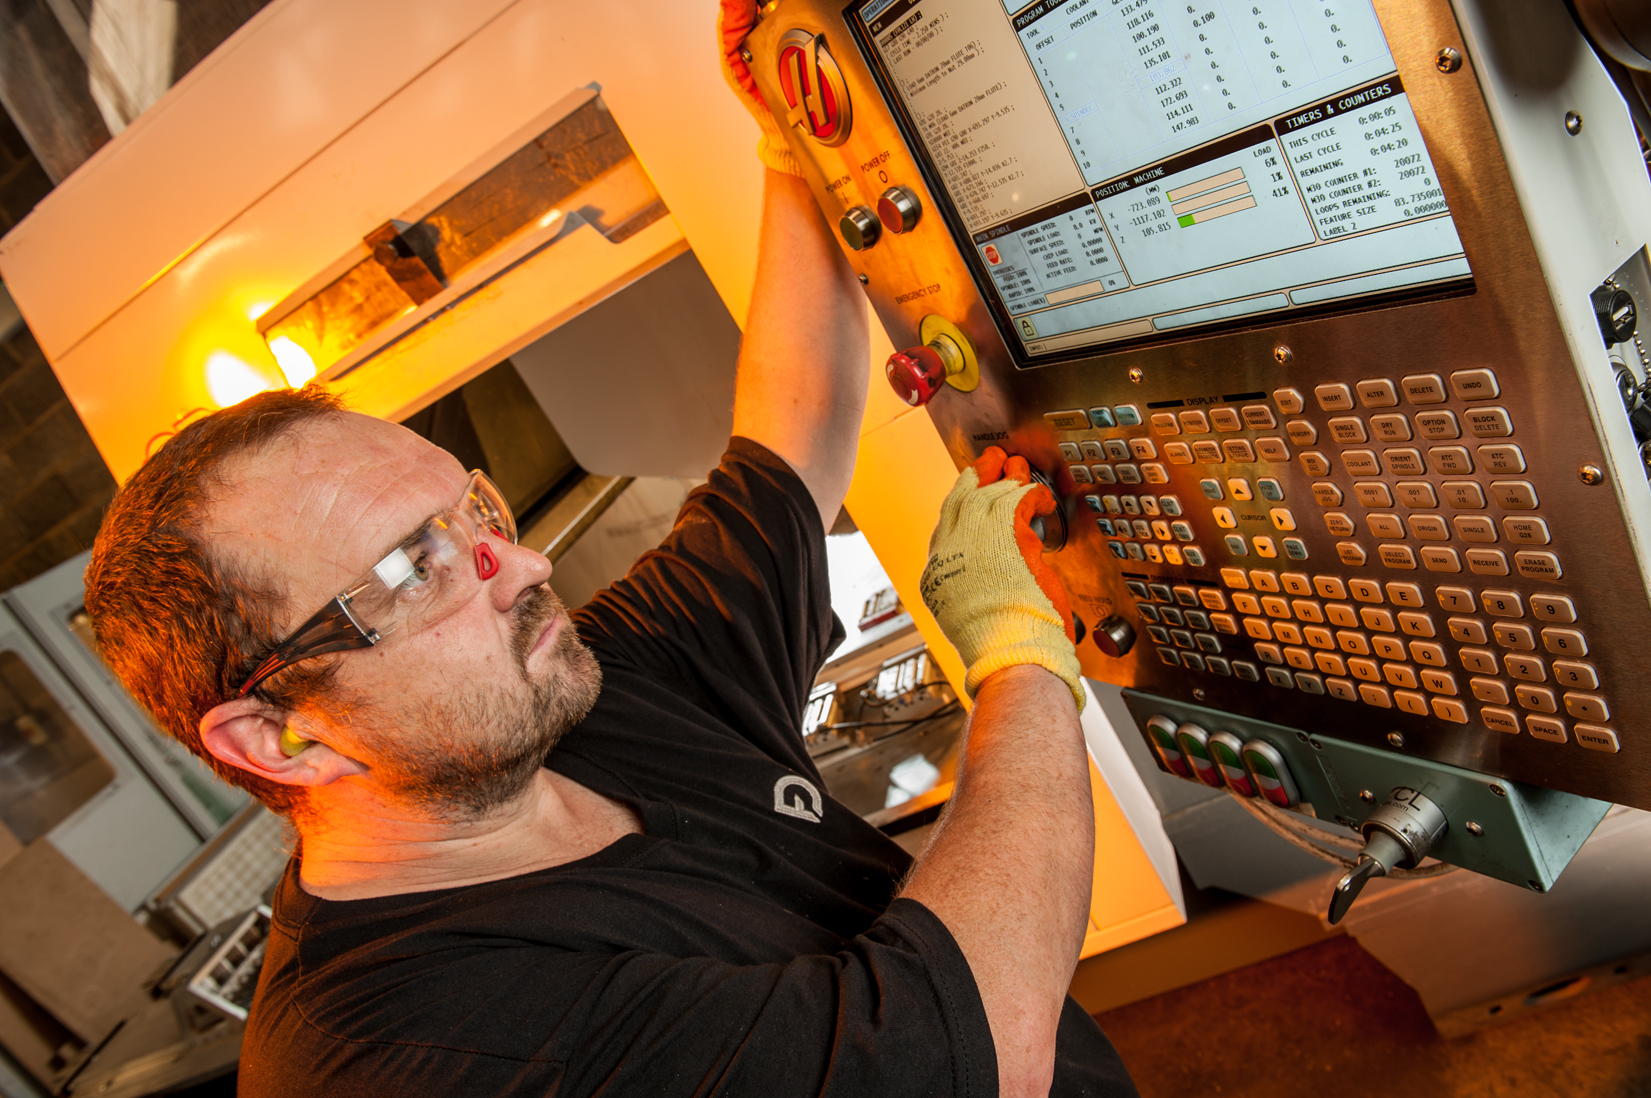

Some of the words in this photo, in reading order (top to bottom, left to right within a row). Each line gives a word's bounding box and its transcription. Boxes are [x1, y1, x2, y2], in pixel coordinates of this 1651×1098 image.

[1016, 4, 1045, 28] PROGRAM
[1126, 9, 1155, 31] 118.116
[1192, 11, 1216, 28] 0.100
[1035, 35, 1055, 51] OFFSET
[1069, 9, 1098, 31] POSITION
[1285, 108, 1322, 129] TIMERS
[1338, 83, 1392, 110] COUNTERS
[1165, 103, 1194, 121] 114.111
[1288, 136, 1308, 149] THIS
[1311, 127, 1336, 142] CYCLE
[1252, 145, 1272, 158] LOAD
[1294, 151, 1313, 164] LAST
[1317, 142, 1342, 157] CYCLE
[860, 157, 879, 174] POWER
[880, 150, 891, 163] OFF
[1264, 156, 1278, 168] 6%
[1299, 159, 1343, 178] REMAINING
[1324, 171, 1359, 189] COUNTER
[1393, 153, 1421, 168] 20072
[1271, 171, 1283, 182] 1%
[826, 181, 841, 194] POWER
[842, 174, 852, 185] ON
[1095, 180, 1130, 199] POSITION:
[1133, 167, 1165, 184] MACHINE
[1328, 183, 1364, 200] COUNTER
[1398, 165, 1426, 180] 20072
[1272, 186, 1289, 198] 41%
[1315, 204, 1340, 216] LOOPS
[1342, 189, 1391, 208] REMAINING:
[1319, 211, 1353, 226] FEATURE
[1356, 205, 1377, 217] SIZE
[1323, 226, 1348, 237] LABEL
[895, 290, 926, 305] EMERGENCY
[927, 283, 941, 294] STOP
[1462, 381, 1482, 390] UNDO
[1366, 391, 1385, 399] ALTER
[1409, 386, 1434, 395] DELETE
[1186, 396, 1219, 406] DISPLAY
[1321, 394, 1342, 402] INSERT
[1054, 418, 1076, 427] RESET
[1422, 418, 1446, 427] OPTION
[1472, 415, 1496, 424] BLOCK
[1335, 424, 1355, 432] SINGLE
[1381, 421, 1393, 430] DRY
[1429, 425, 1446, 434] STOP
[1474, 423, 1500, 431] DELETE
[1337, 431, 1357, 439] BLOCK
[1383, 428, 1397, 436] RUN
[1390, 455, 1411, 463] ORIENT
[1441, 454, 1453, 462] ATC
[1491, 452, 1504, 460] ATC
[1346, 460, 1372, 468] COOLANT
[1391, 461, 1417, 470] SPINDLE
[1442, 461, 1457, 470] FWD
[1493, 460, 1507, 468] REV
[1240, 513, 1267, 522] CURSOR
[1379, 523, 1390, 531] ALL
[1462, 526, 1486, 534] SINGLE
[1512, 524, 1533, 532] HOME
[1518, 531, 1532, 539] G28
[1384, 550, 1406, 558] SELECT
[1384, 557, 1411, 565] PROGRAM
[1472, 559, 1500, 567] RECEIVE
[1524, 558, 1547, 566] ERASE
[1521, 565, 1555, 574] PROGRAM
[1225, 575, 1244, 585] SHIFT
[1485, 716, 1515, 727] CANCEL
[1533, 725, 1559, 736] SPACE
[1582, 735, 1609, 745] ENTER
